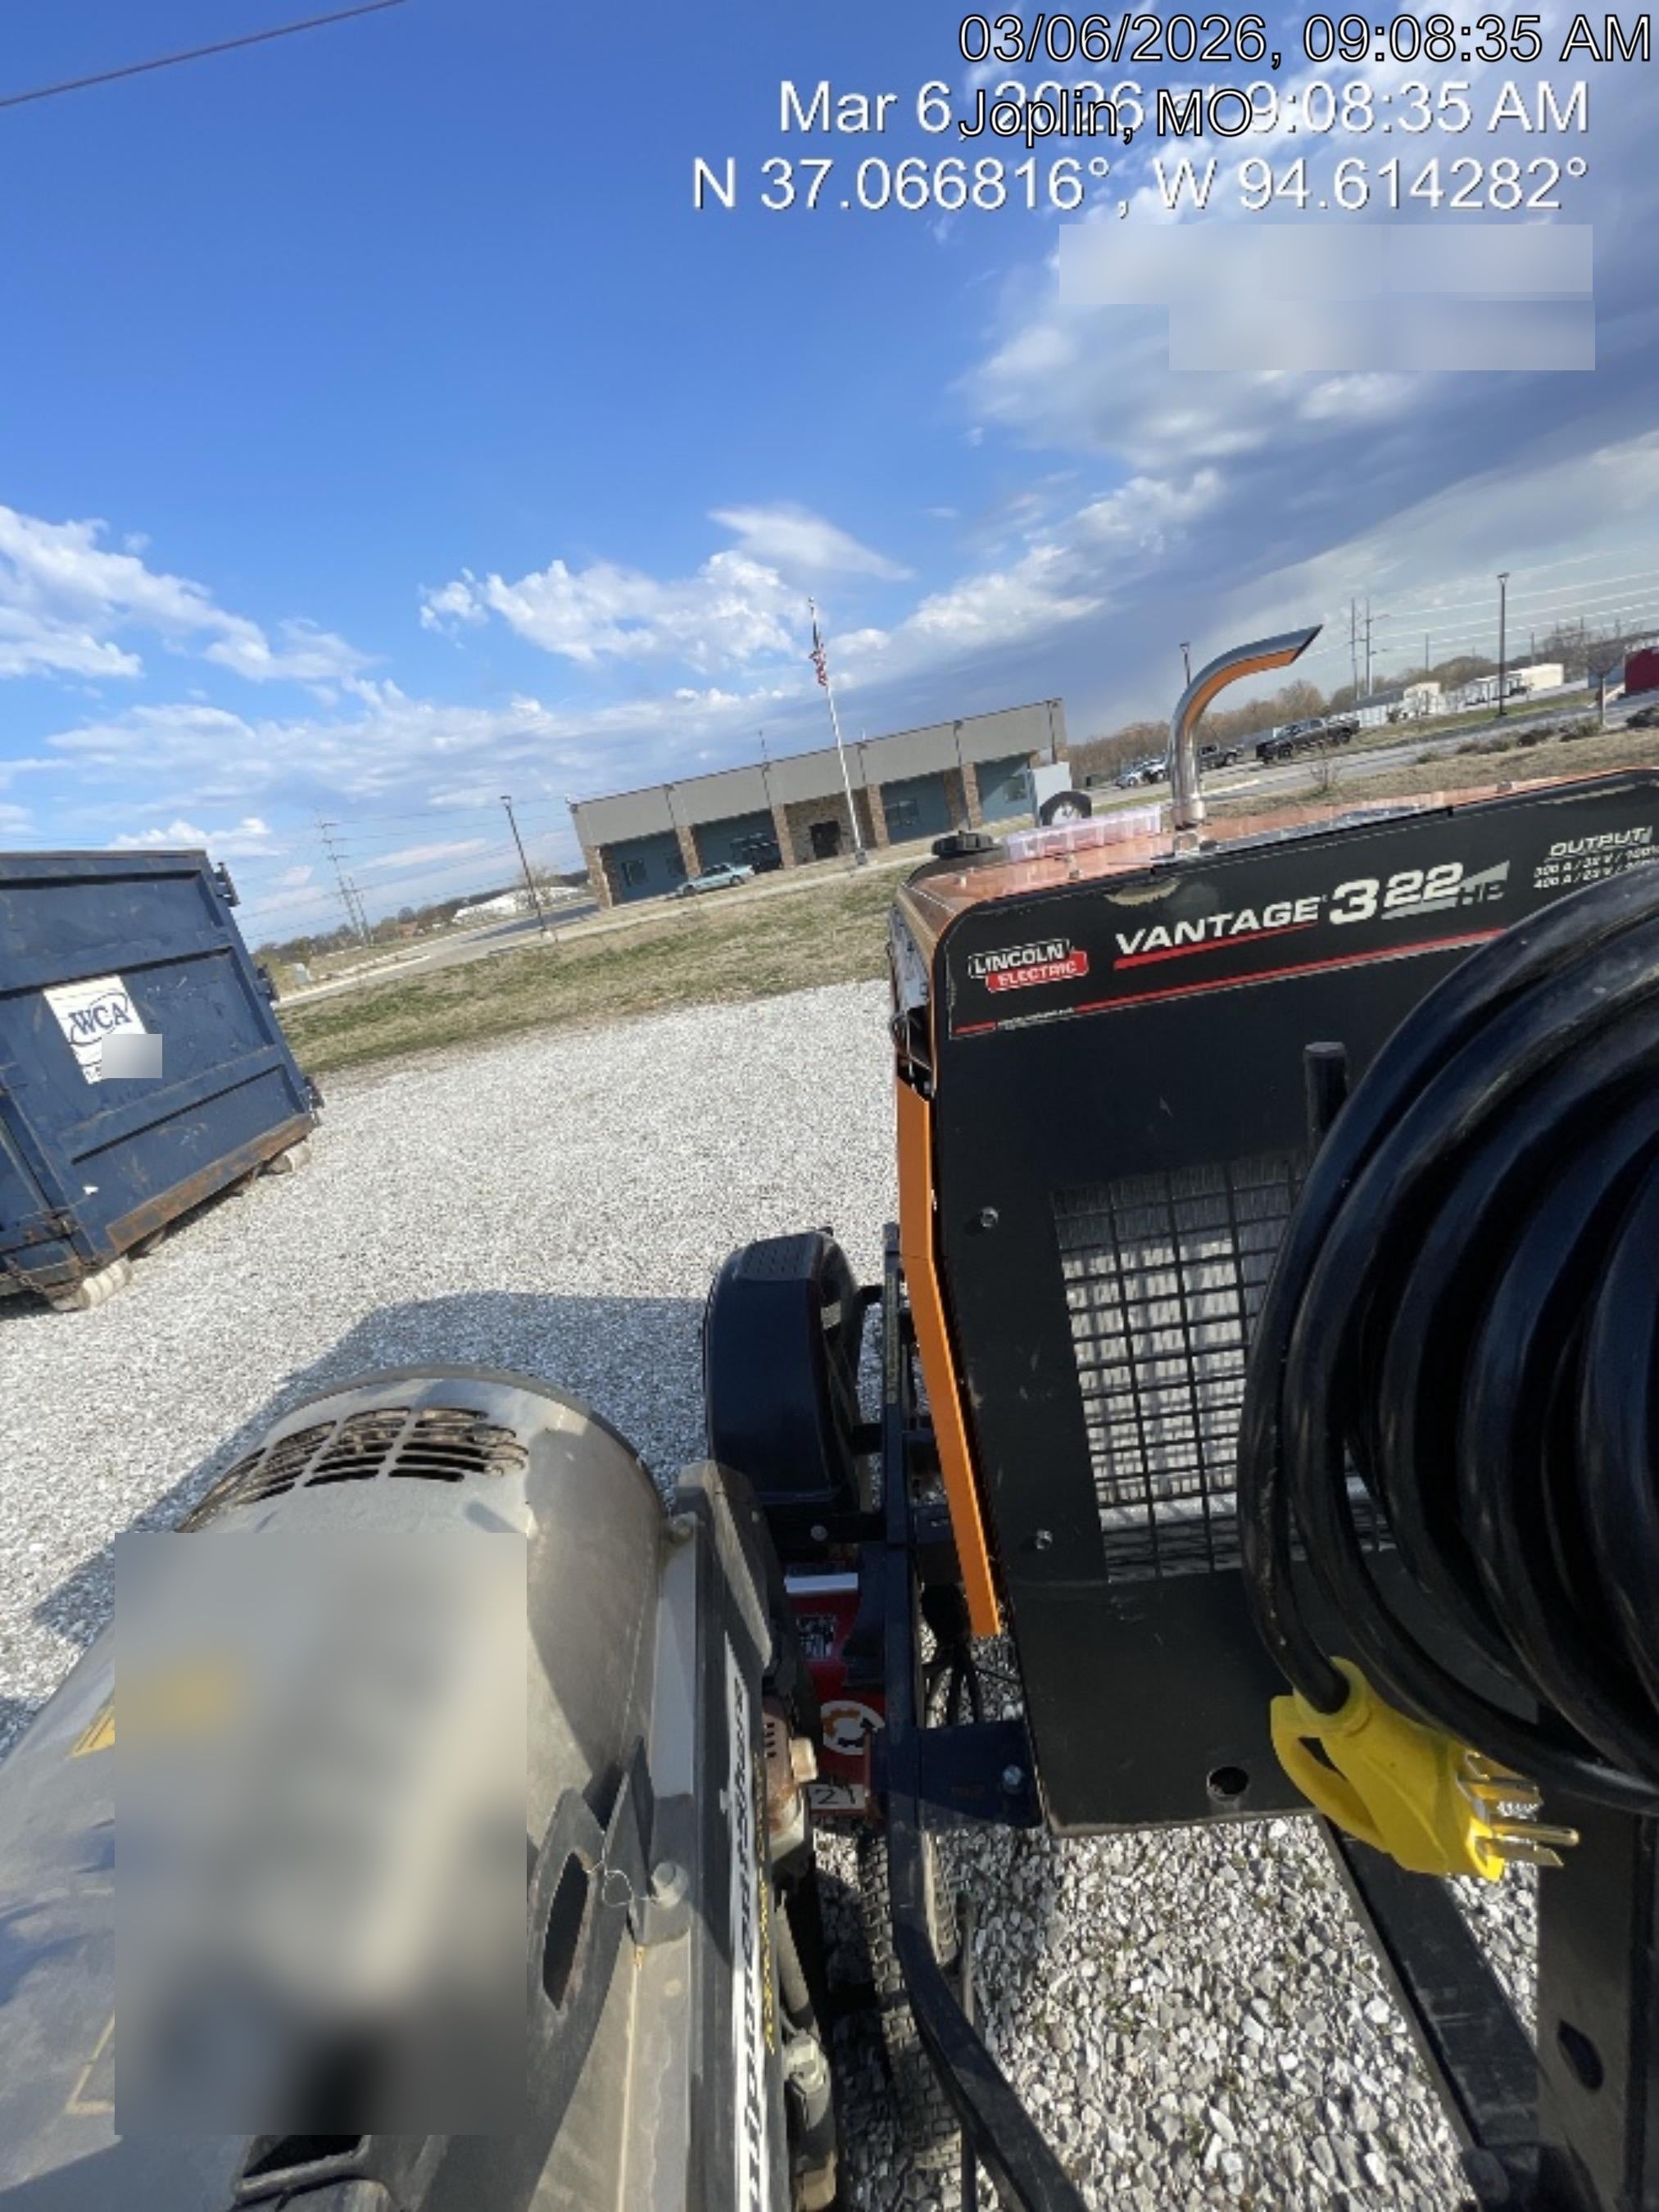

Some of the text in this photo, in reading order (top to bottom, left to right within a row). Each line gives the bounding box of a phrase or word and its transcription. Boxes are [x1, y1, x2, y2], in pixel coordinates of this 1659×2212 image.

[1548, 826, 1647, 857] OUTPUT
[1115, 896, 1321, 955] VANTAGE
[1329, 862, 1464, 925] 322
[973, 943, 1064, 975] LINCOLN
[997, 959, 1077, 986] ELECTRIC
[68, 1001, 133, 1036] WCA
